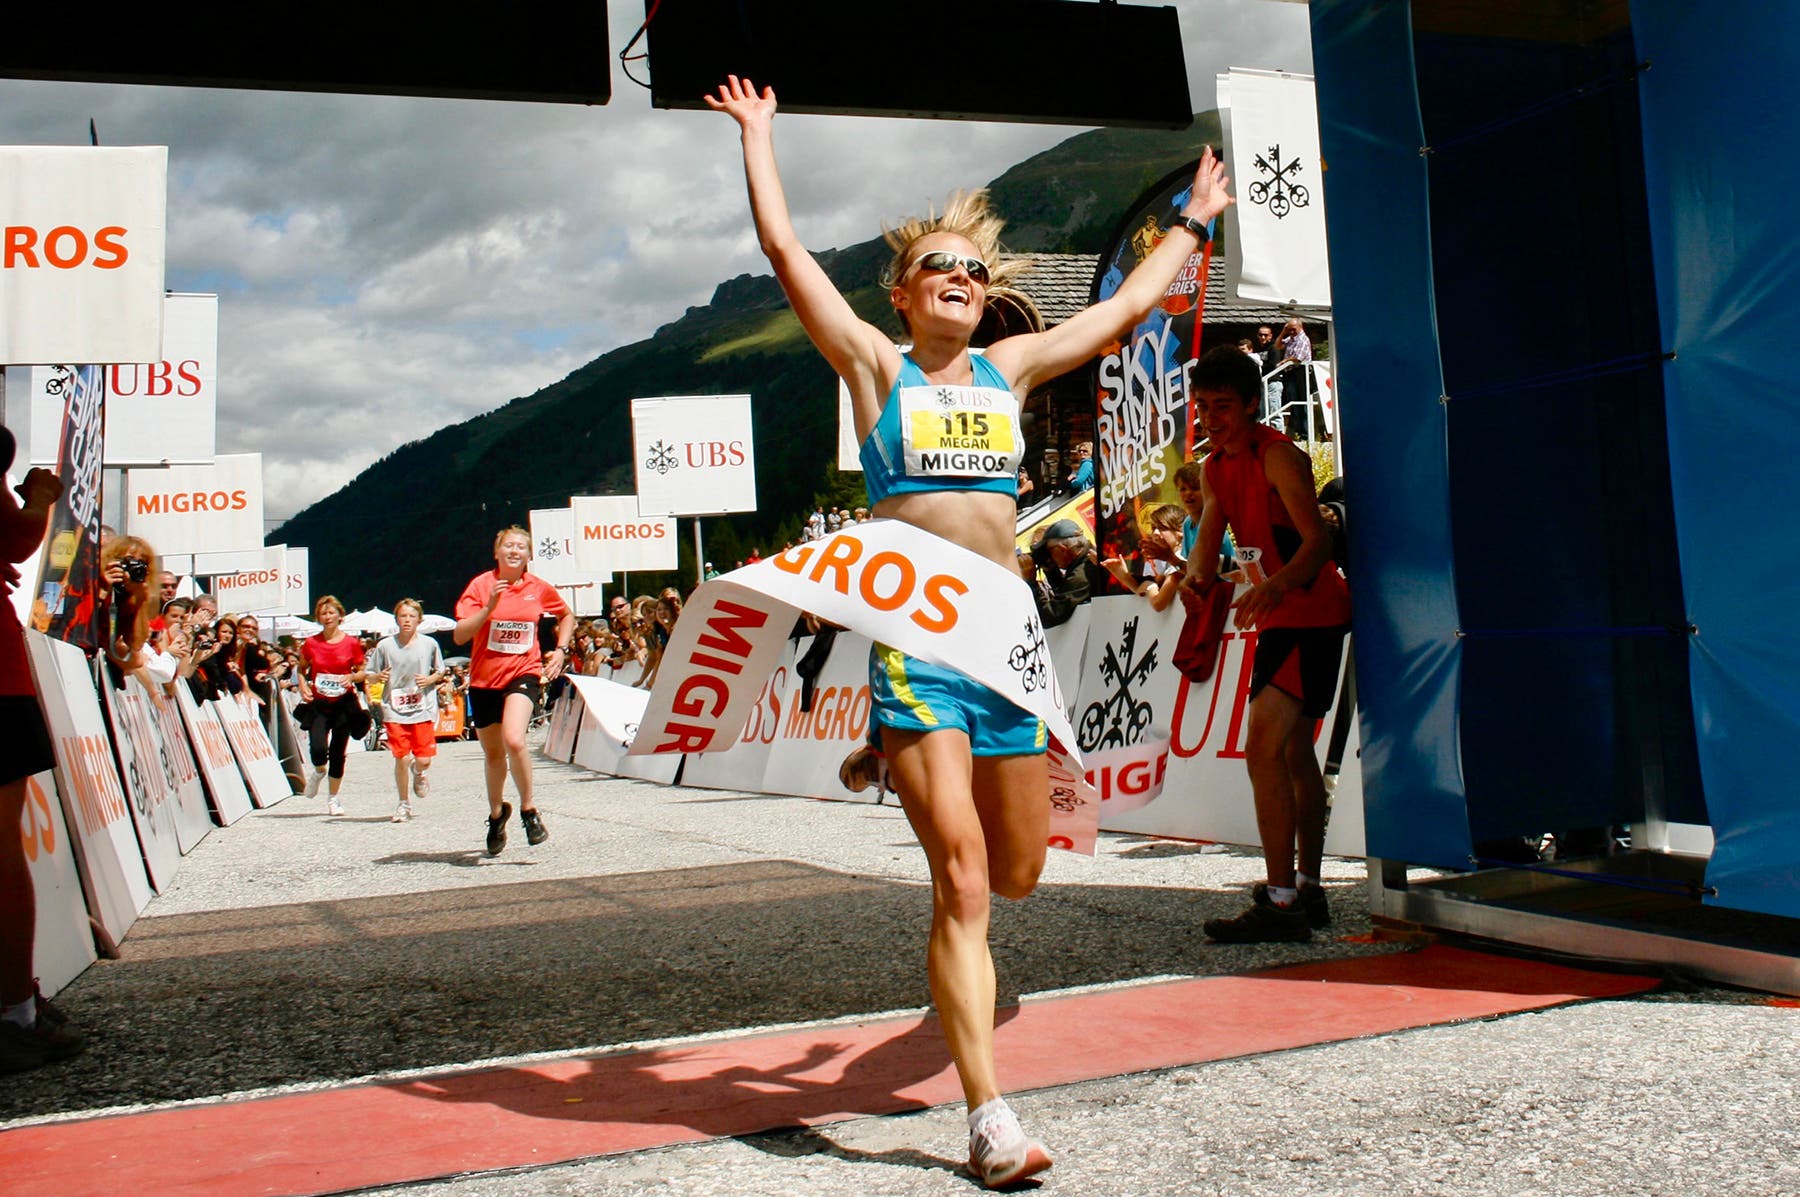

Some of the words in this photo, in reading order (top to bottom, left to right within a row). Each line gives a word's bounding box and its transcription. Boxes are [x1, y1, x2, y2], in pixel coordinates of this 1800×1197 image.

[1099, 317, 1174, 412] SKY
[105, 360, 202, 397] UBS
[959, 390, 993, 408] UBS
[939, 412, 990, 436] 115
[684, 440, 745, 469] UBS
[939, 437, 991, 460] MEGAN
[1100, 413, 1176, 485] WORLD
[921, 453, 1008, 472] MIGROS
[1100, 450, 1167, 520] SERIES
[137, 490, 247, 515] MIGROS
[583, 522, 666, 541] MIGROS
[218, 568, 279, 590] MIGROS
[496, 622, 529, 630] MIGROS
[500, 630, 521, 639] 280
[783, 684, 871, 741] MIGRO
